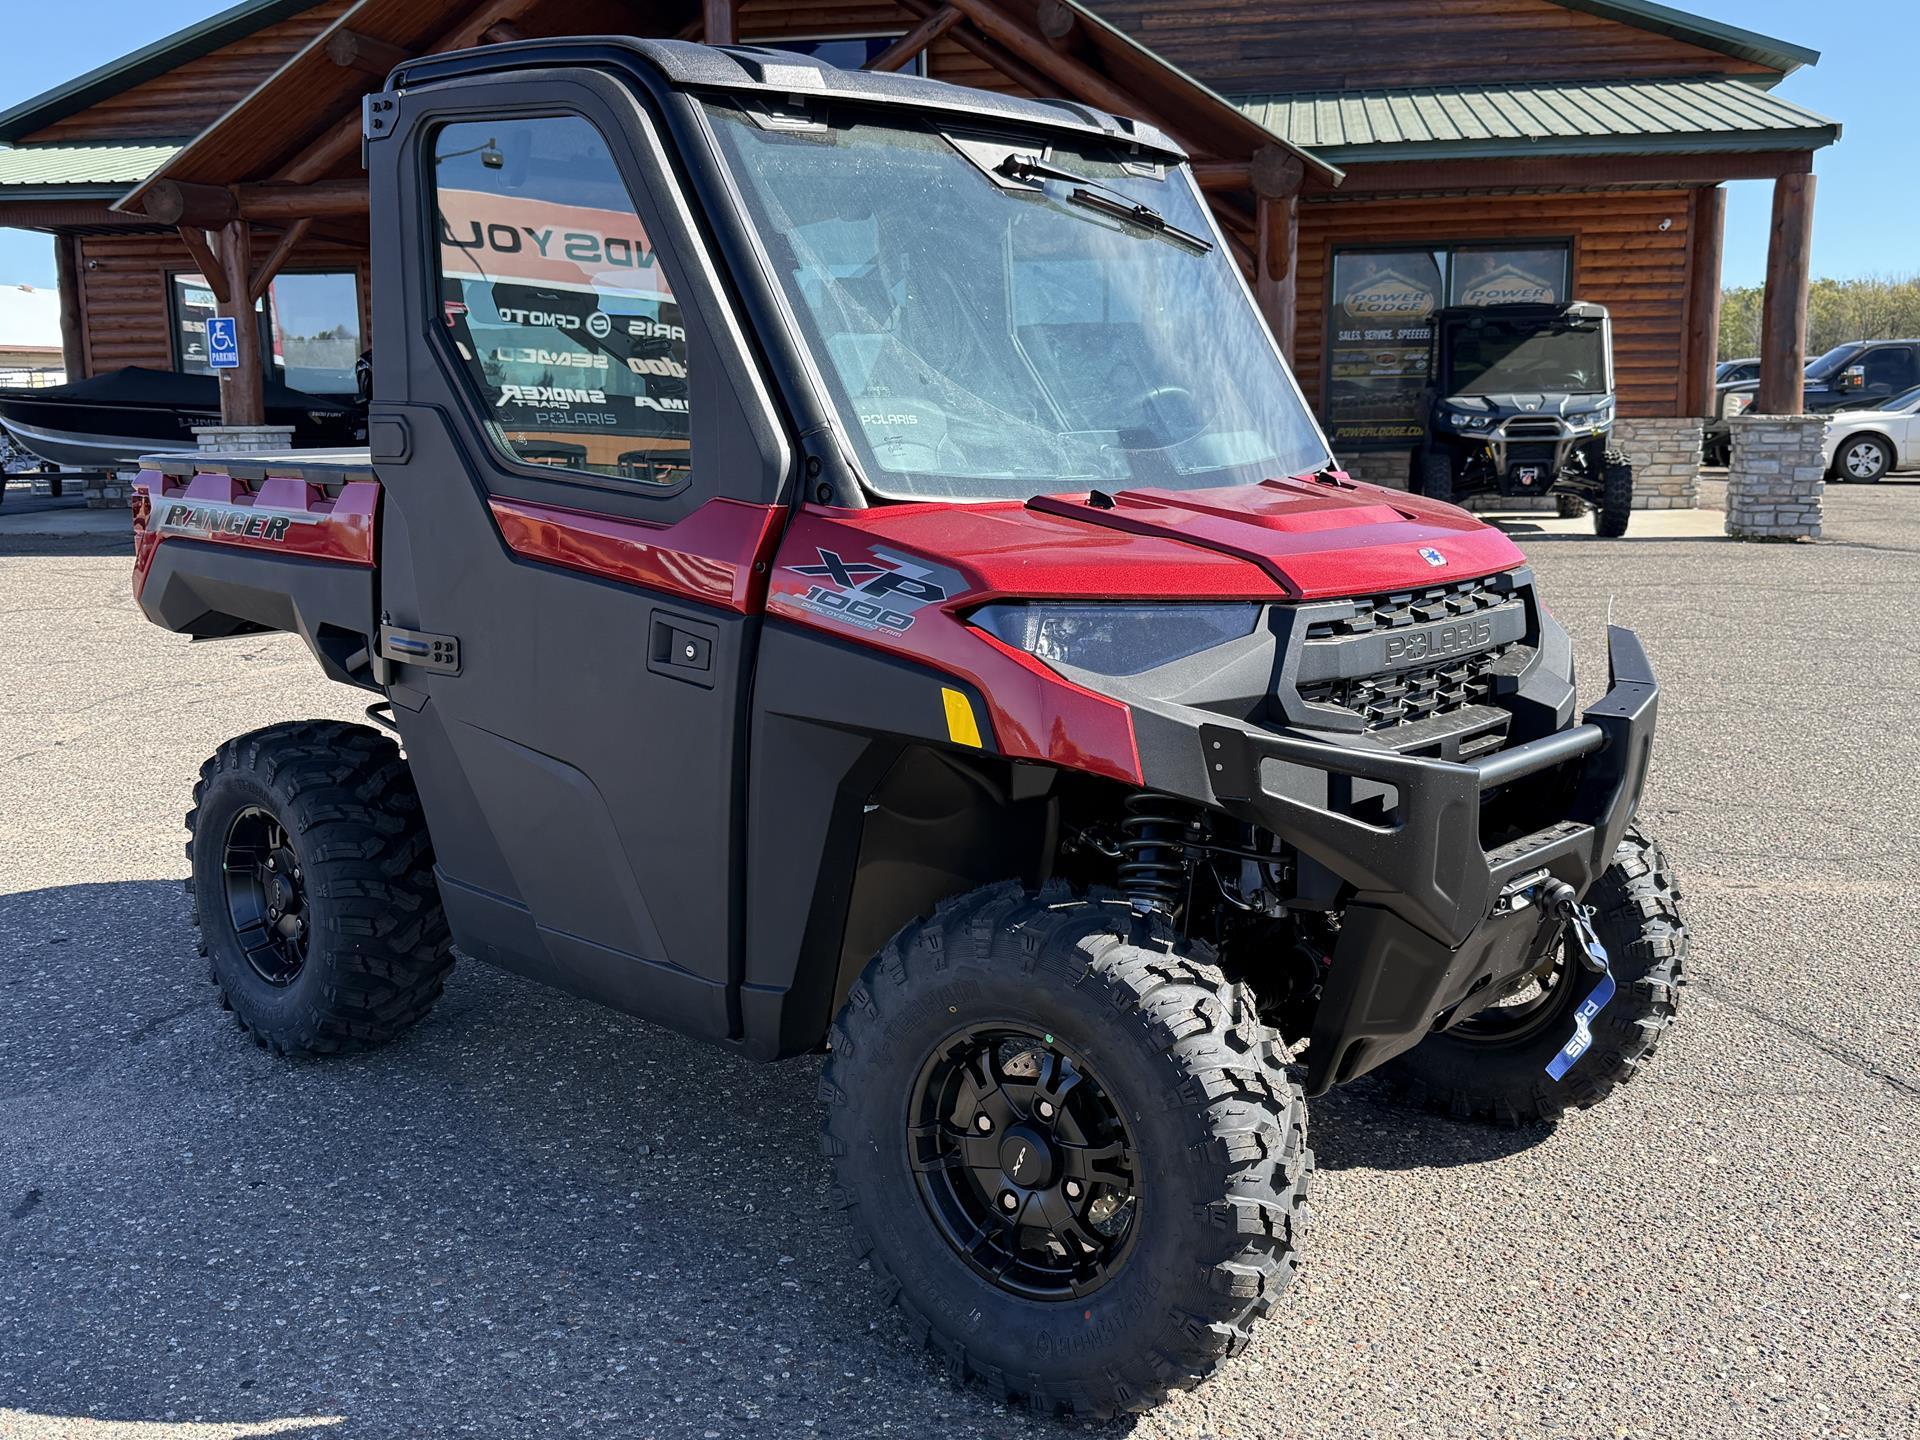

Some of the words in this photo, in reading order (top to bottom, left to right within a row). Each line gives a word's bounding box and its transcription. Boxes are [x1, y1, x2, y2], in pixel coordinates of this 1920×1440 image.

[1352, 293, 1425, 305] POWER
[1470, 288, 1546, 300] POWER
[1355, 302, 1422, 313] LODGE
[211, 352, 237, 362] PARKING
[535, 412, 617, 426] POLARIS
[860, 414, 918, 426] POLARIS
[164, 504, 291, 541] RANGER
[782, 547, 947, 604] XP
[804, 585, 916, 632] 1000
[878, 626, 903, 639] CAM
[1385, 620, 1491, 666] POLARIS
[1012, 1146, 1027, 1177] XP
